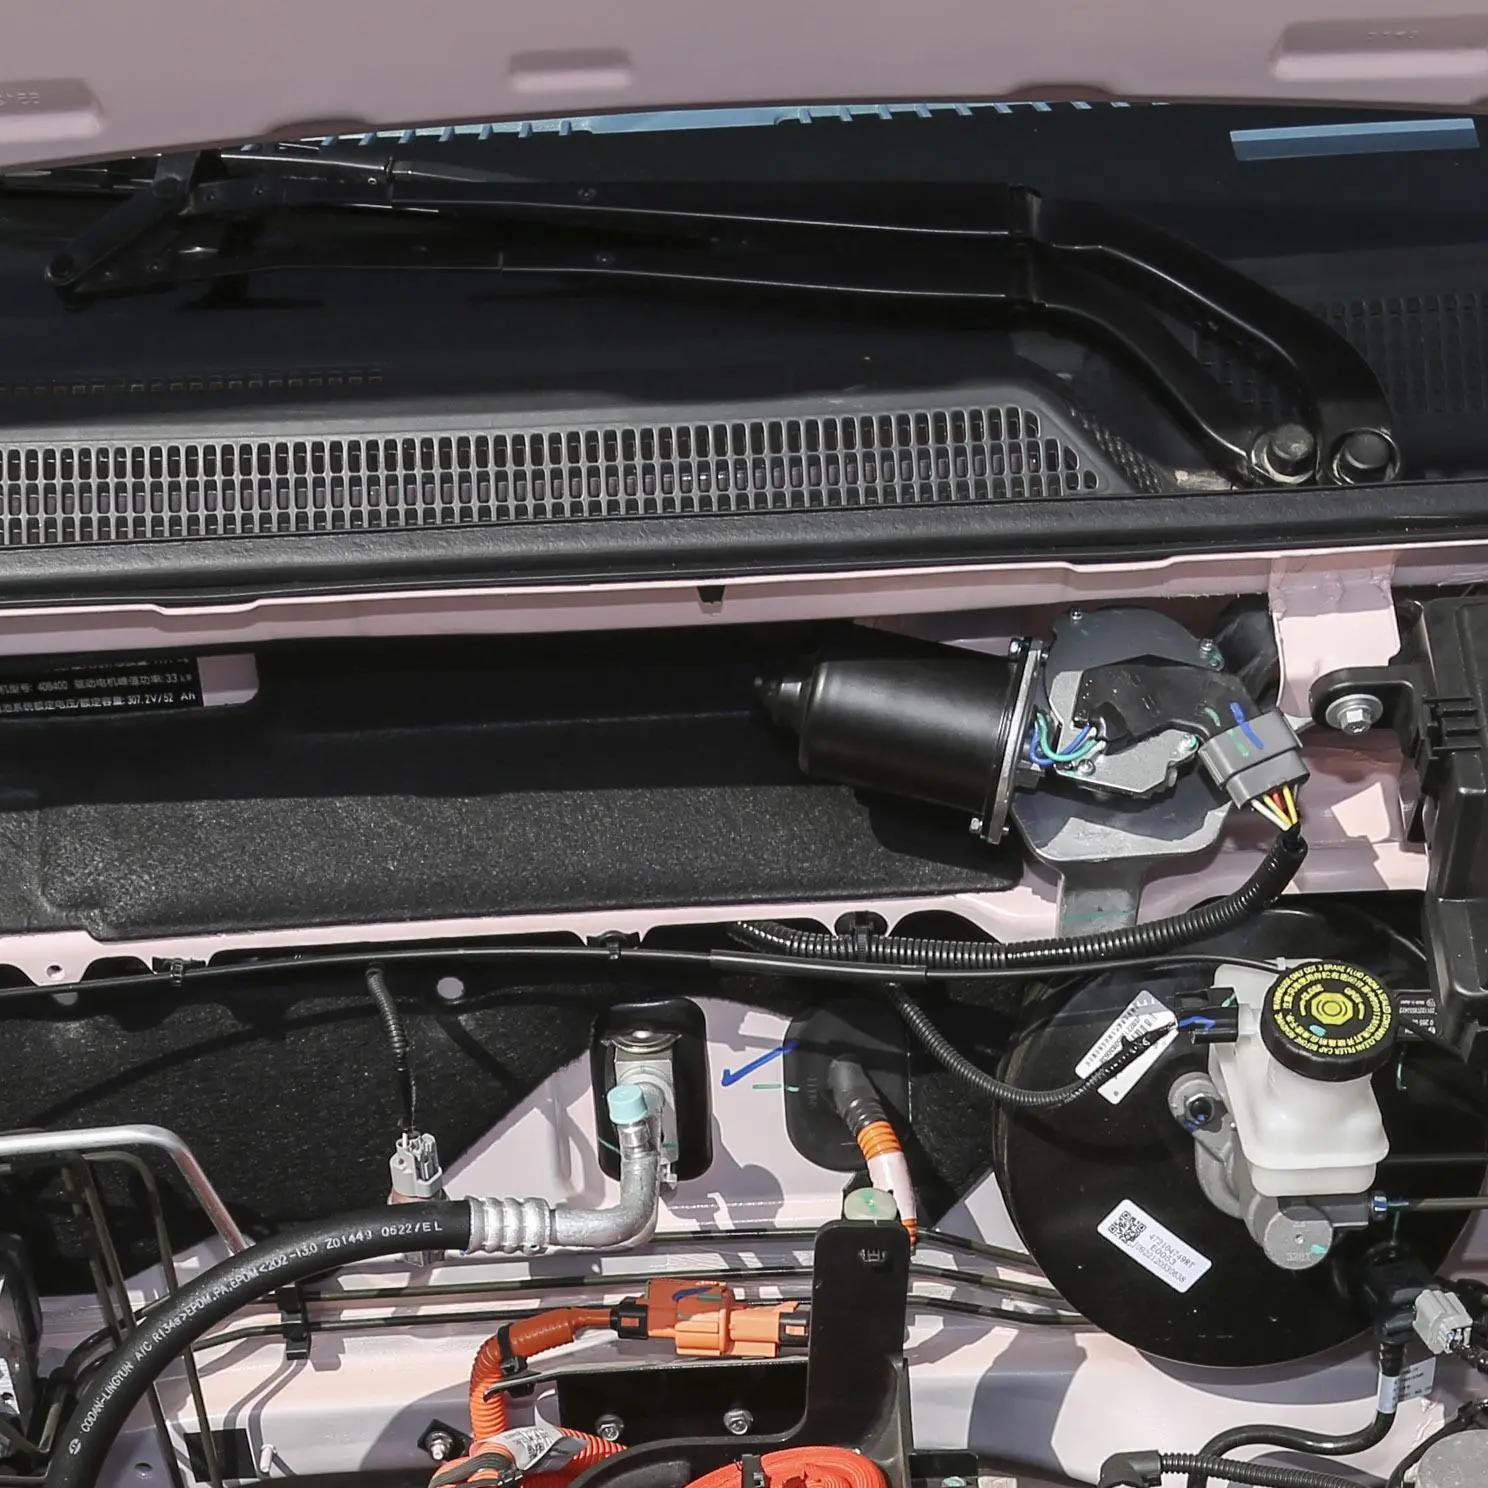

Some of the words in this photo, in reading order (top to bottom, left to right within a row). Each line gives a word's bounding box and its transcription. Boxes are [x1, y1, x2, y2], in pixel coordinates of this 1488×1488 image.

[1323, 964, 1346, 972] BRAKE
[1343, 987, 1363, 1003] OPEN
[134, 1341, 153, 1361] A/C
